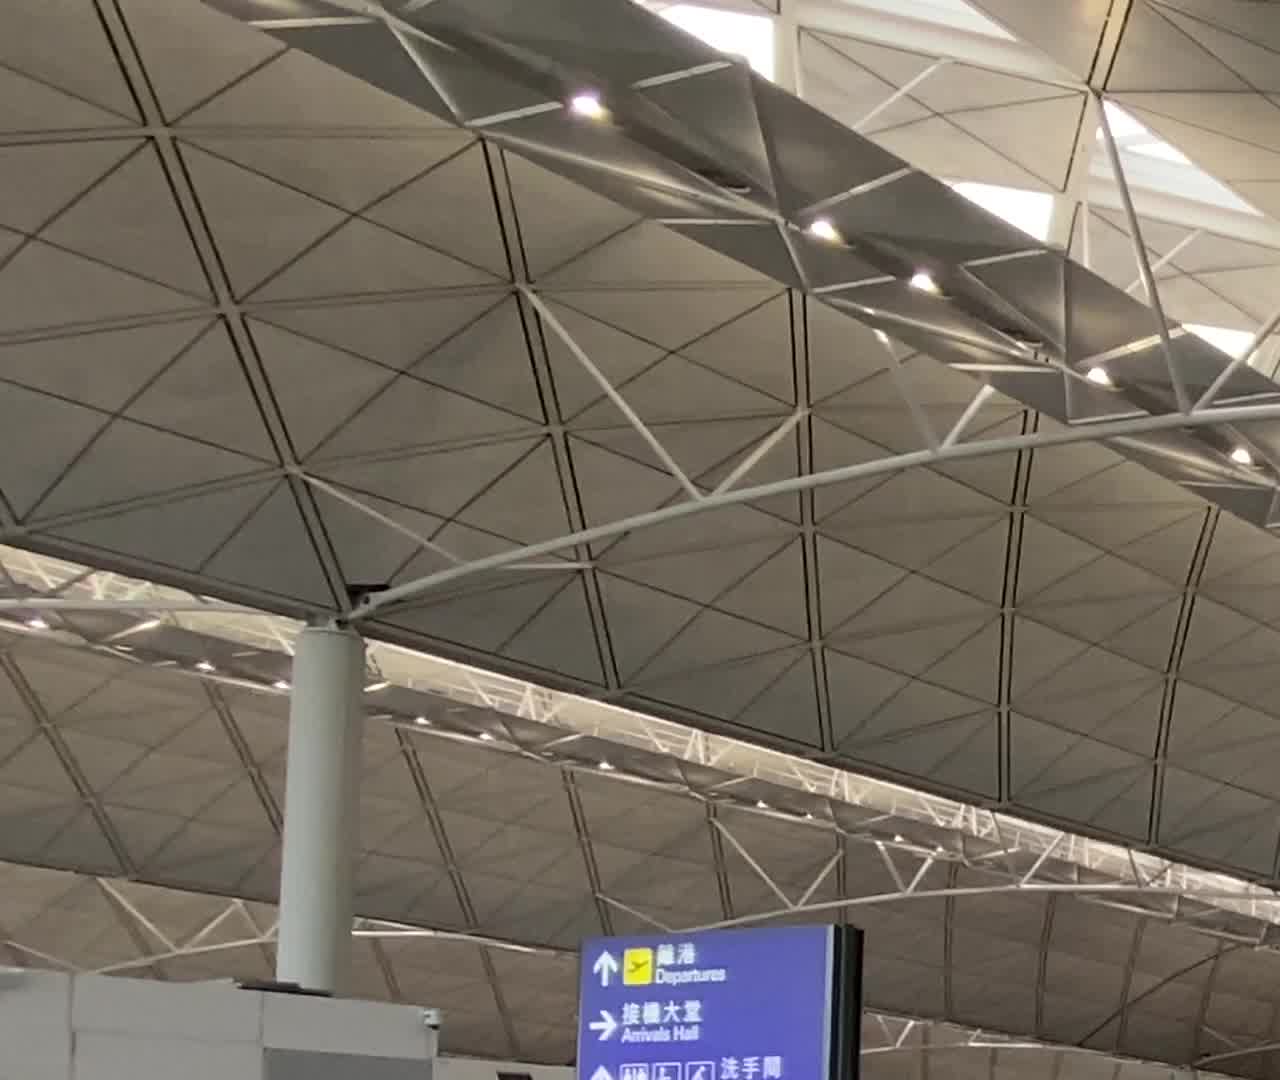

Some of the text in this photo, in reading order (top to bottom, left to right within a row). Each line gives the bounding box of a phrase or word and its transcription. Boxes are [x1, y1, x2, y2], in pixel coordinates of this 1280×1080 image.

[655, 968, 727, 986] Departures
[622, 1000, 703, 1024] 接機大堂
[621, 1024, 700, 1043] Arrivals Hall
[719, 1055, 782, 1080] 洗手間
